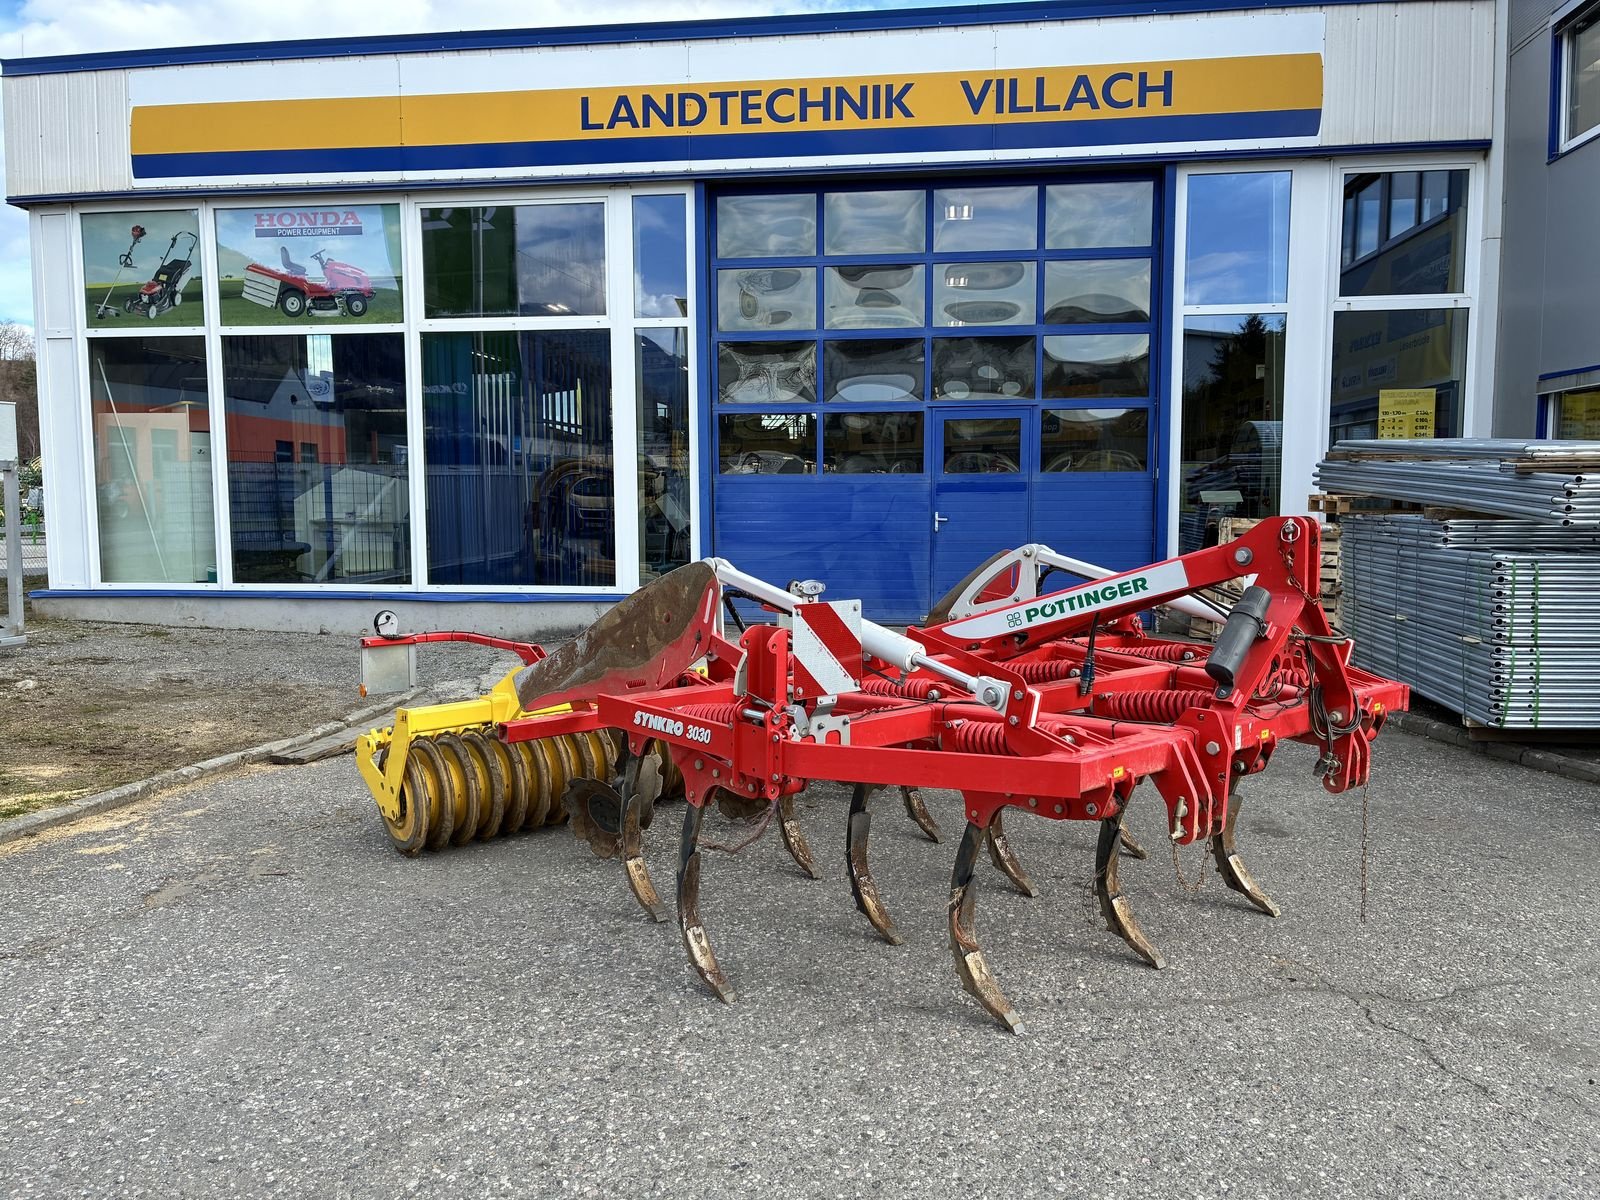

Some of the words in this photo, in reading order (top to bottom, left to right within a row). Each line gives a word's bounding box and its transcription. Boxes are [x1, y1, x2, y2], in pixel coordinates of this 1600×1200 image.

[580, 82, 915, 130] LANDTECHNIK
[959, 70, 1173, 115] VILLACH
[254, 211, 362, 227] HONDA
[277, 228, 301, 236] POWER
[303, 227, 340, 235] EQUIPMENT
[1025, 577, 1149, 623] PÖTTINGER
[633, 710, 684, 737] SYNKRO
[686, 724, 711, 744] 3030
